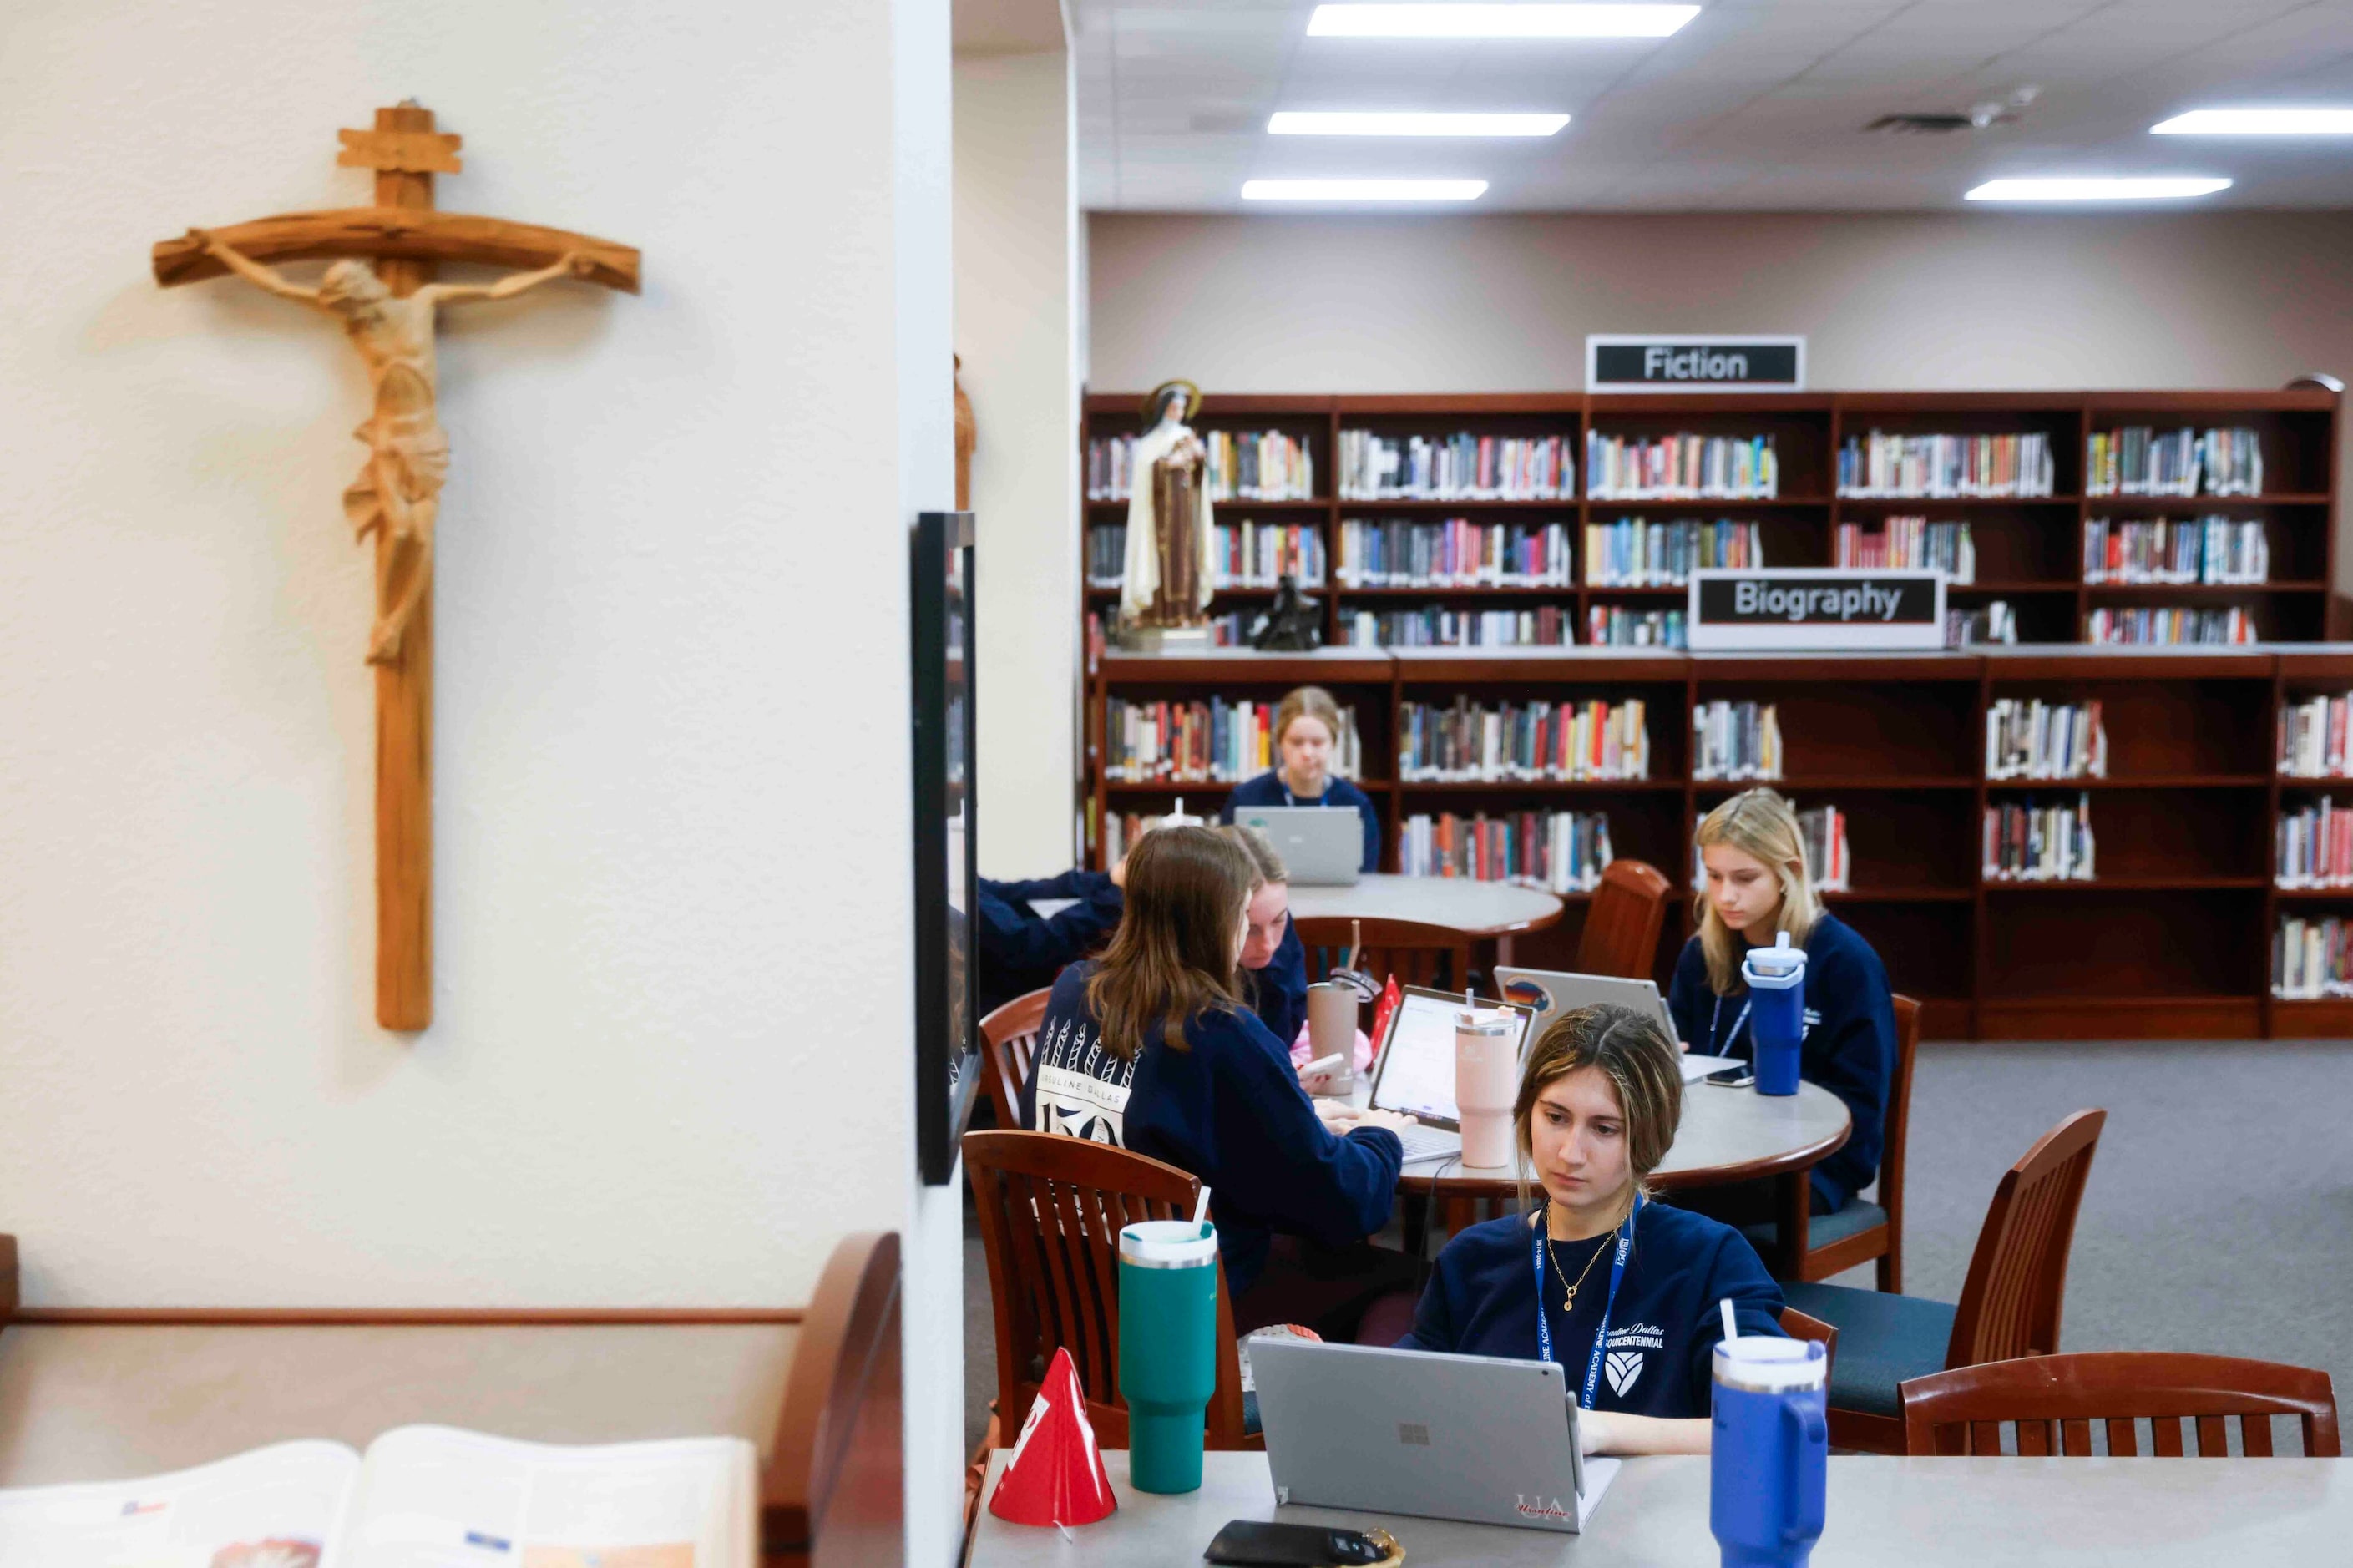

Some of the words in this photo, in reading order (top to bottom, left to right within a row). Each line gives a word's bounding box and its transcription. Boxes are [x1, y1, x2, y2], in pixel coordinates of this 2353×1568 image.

[1644, 346, 1748, 379] Fiction
[1734, 581, 1903, 621] Biography
[1629, 1322, 1665, 1336] Dallas
[1605, 1336, 1663, 1349] QUICENTENNIAL
[1541, 1346, 1551, 1363] LINE
[1586, 1349, 1602, 1393] ACADEMY
[1585, 1393, 1591, 1404] of
